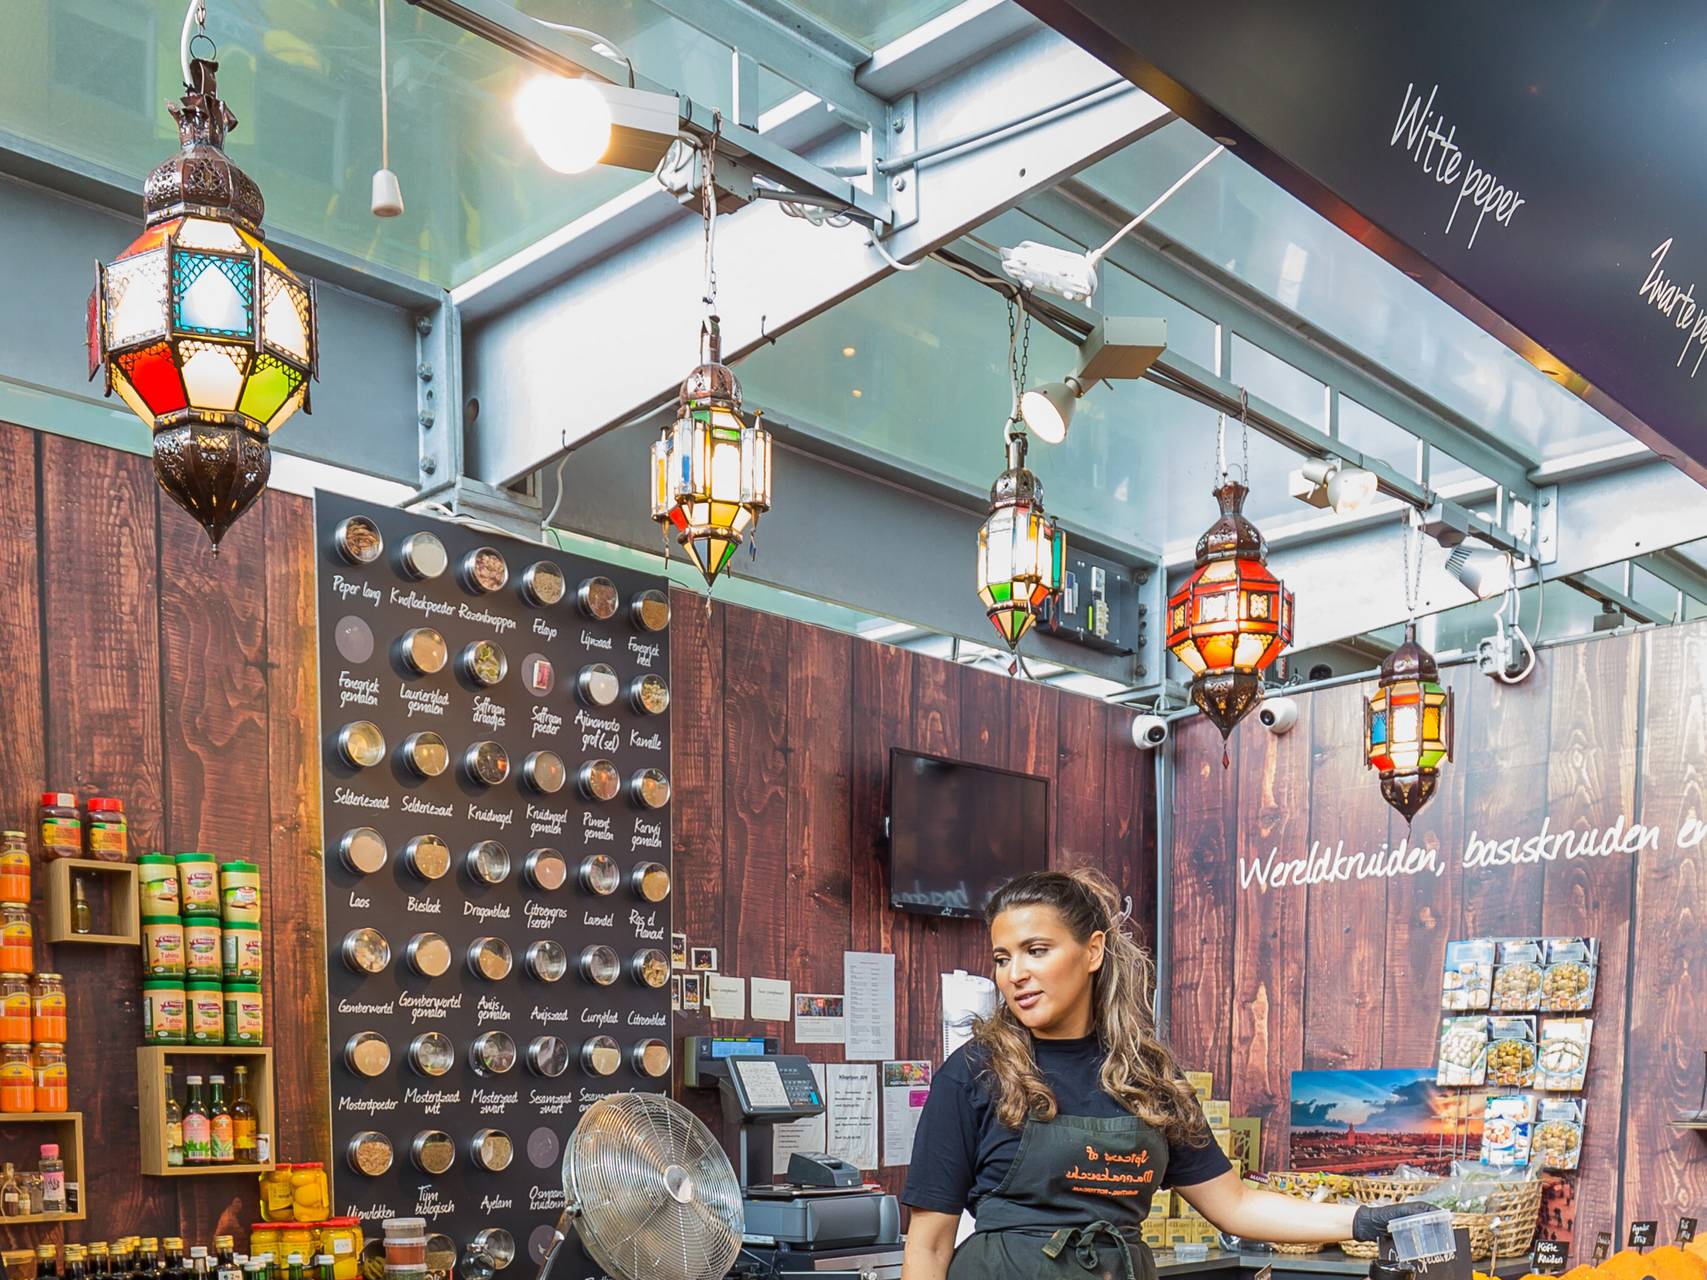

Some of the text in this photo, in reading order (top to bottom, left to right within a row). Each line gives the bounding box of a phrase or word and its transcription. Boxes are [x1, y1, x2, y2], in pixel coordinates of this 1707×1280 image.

[1390, 83, 1525, 249] Witte peper
[1639, 238, 1696, 329] Zwarte
[333, 575, 361, 600] Peper
[340, 690, 378, 708] gemalen
[407, 701, 444, 717] gemalen
[630, 729, 662, 750] Kamille
[467, 803, 513, 830] Kruidnagel
[582, 812, 610, 828] Piment
[1463, 815, 1659, 869] basiskruiden
[349, 892, 371, 908] Laos
[407, 896, 442, 913] Bieslook
[338, 999, 394, 1015] Gemberwortel
[399, 990, 462, 1009] Gemberwortel
[411, 1008, 446, 1024] gemalen
